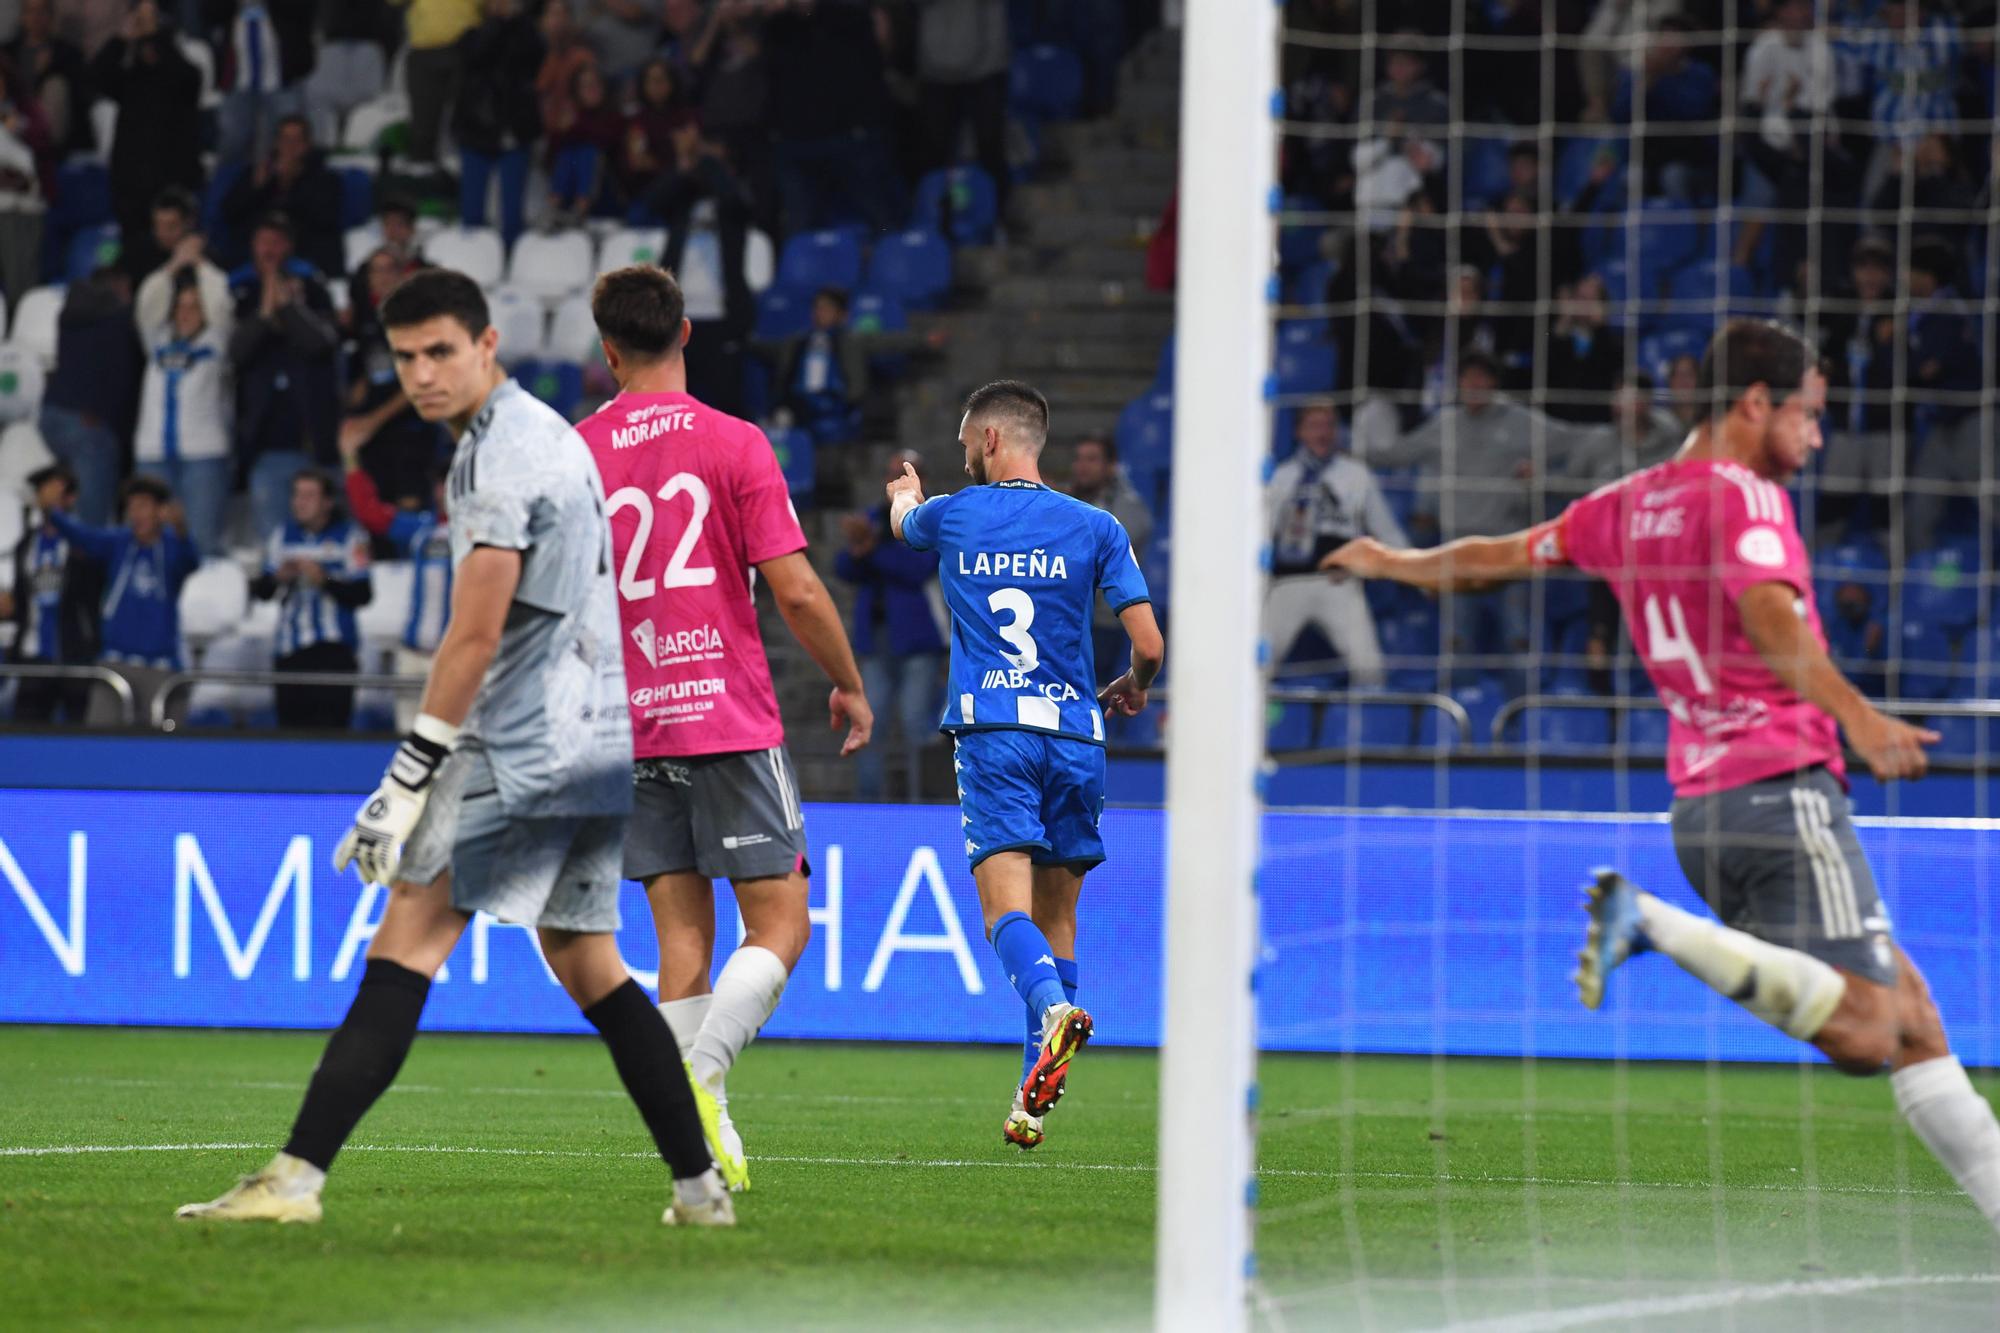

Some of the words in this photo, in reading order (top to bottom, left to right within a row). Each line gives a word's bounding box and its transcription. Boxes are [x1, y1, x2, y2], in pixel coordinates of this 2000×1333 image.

[612, 412, 695, 449] MORANTE
[605, 471, 717, 600] 22
[958, 549, 1067, 579] LAPEÑA
[657, 624, 725, 657] GARCÍA
[987, 588, 1040, 674] 3
[1644, 593, 1714, 695] 4
[654, 678, 726, 702] HYUNDAI
